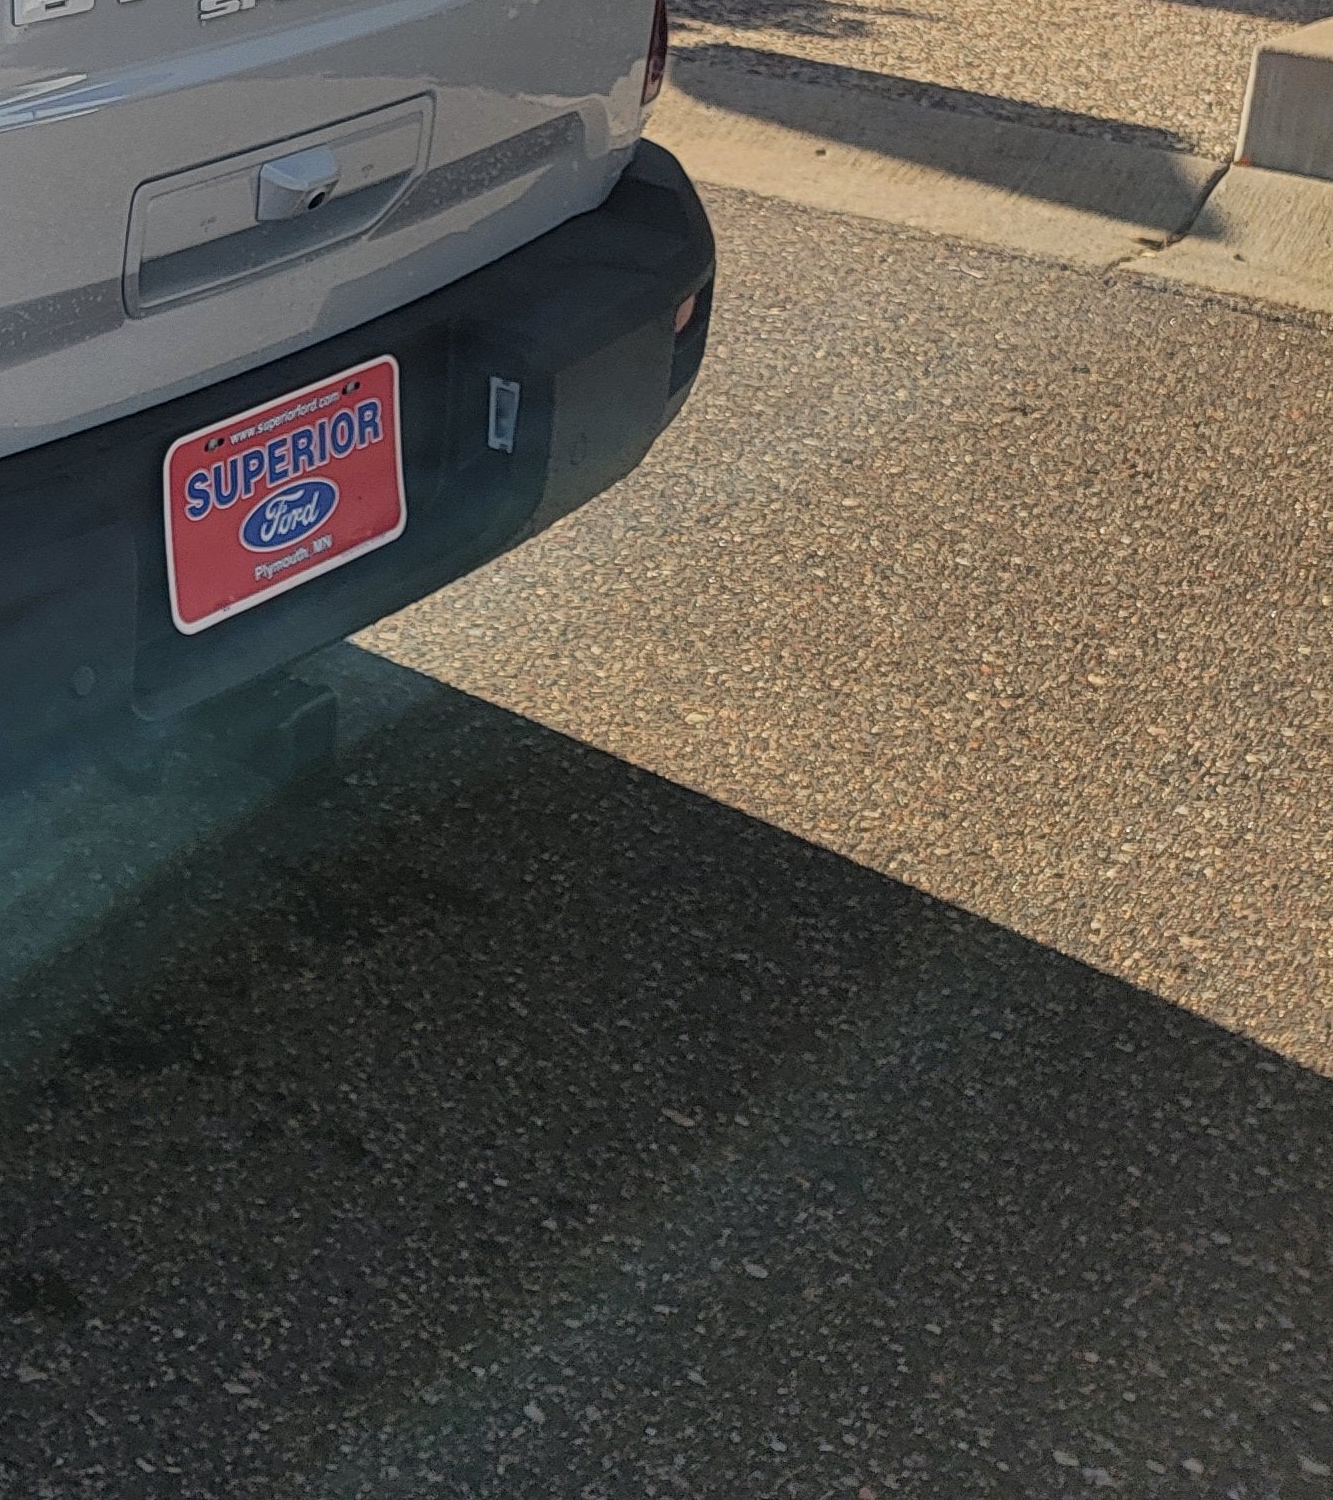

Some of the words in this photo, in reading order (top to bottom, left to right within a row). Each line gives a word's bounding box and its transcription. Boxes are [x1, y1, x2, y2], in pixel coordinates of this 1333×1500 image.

[229, 390, 341, 445] www.superiorford.com
[184, 398, 384, 522] SUPERIOR
[260, 488, 320, 542] Ford
[312, 534, 333, 556] MN
